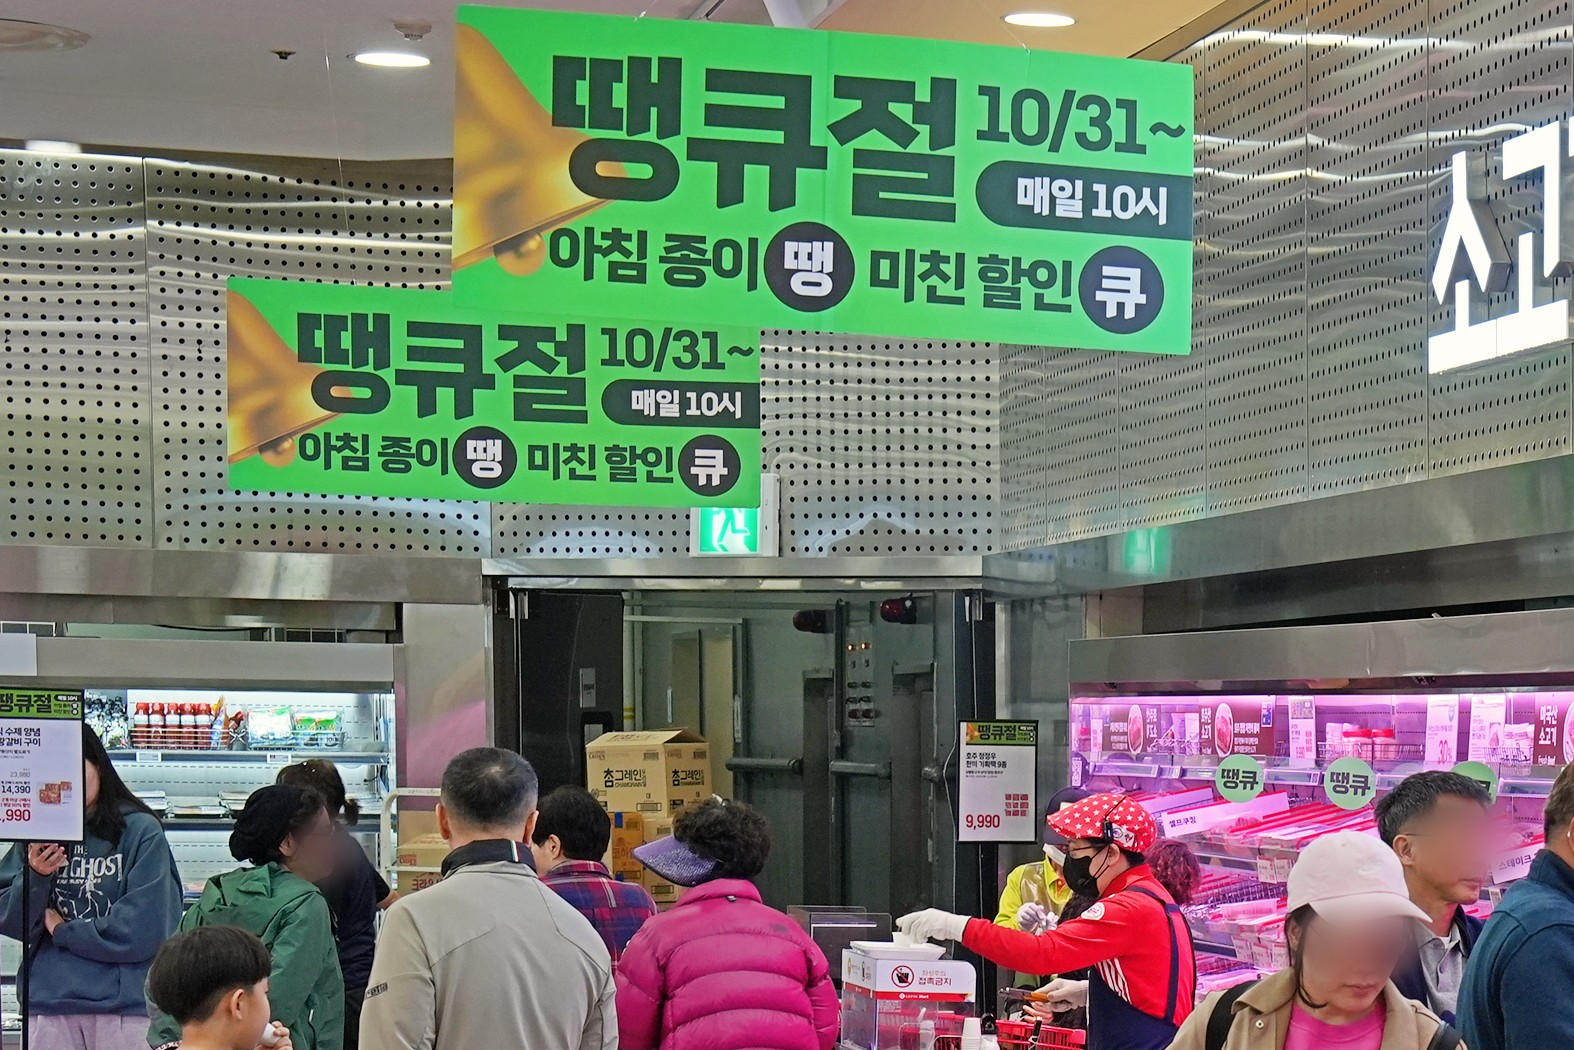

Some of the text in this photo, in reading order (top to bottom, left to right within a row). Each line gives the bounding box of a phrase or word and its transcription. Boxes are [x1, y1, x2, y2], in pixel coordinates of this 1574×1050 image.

[976, 84, 1187, 155] 10/31~
[551, 55, 957, 223] 땡큐절
[1016, 177, 1168, 227] 매일 10시
[549, 227, 1147, 320] 아침 종이 땡 미친 할인 큐
[600, 327, 755, 371] 10/31~
[297, 312, 589, 424] 땡큐절
[631, 389, 742, 420] 매일 10시
[299, 432, 728, 486] 아침 종이 땡 미친 할인 큐
[1540, 705, 1558, 725] 미국산
[5, 727, 41, 737] 수제 양념
[24, 737, 41, 747] 구이
[978, 724, 1016, 741] 땡큐절
[1539, 727, 1556, 746] 소고기
[2, 785, 31, 794] 14,390
[1221, 768, 1259, 790] 땡큐
[1330, 771, 1371, 797] 땡큐
[966, 815, 1000, 829] 9,990
[1168, 815, 1197, 828] 셀프쿠킹
[1499, 854, 1531, 870] 스테이크
[918, 977, 952, 986] 접촉금지
